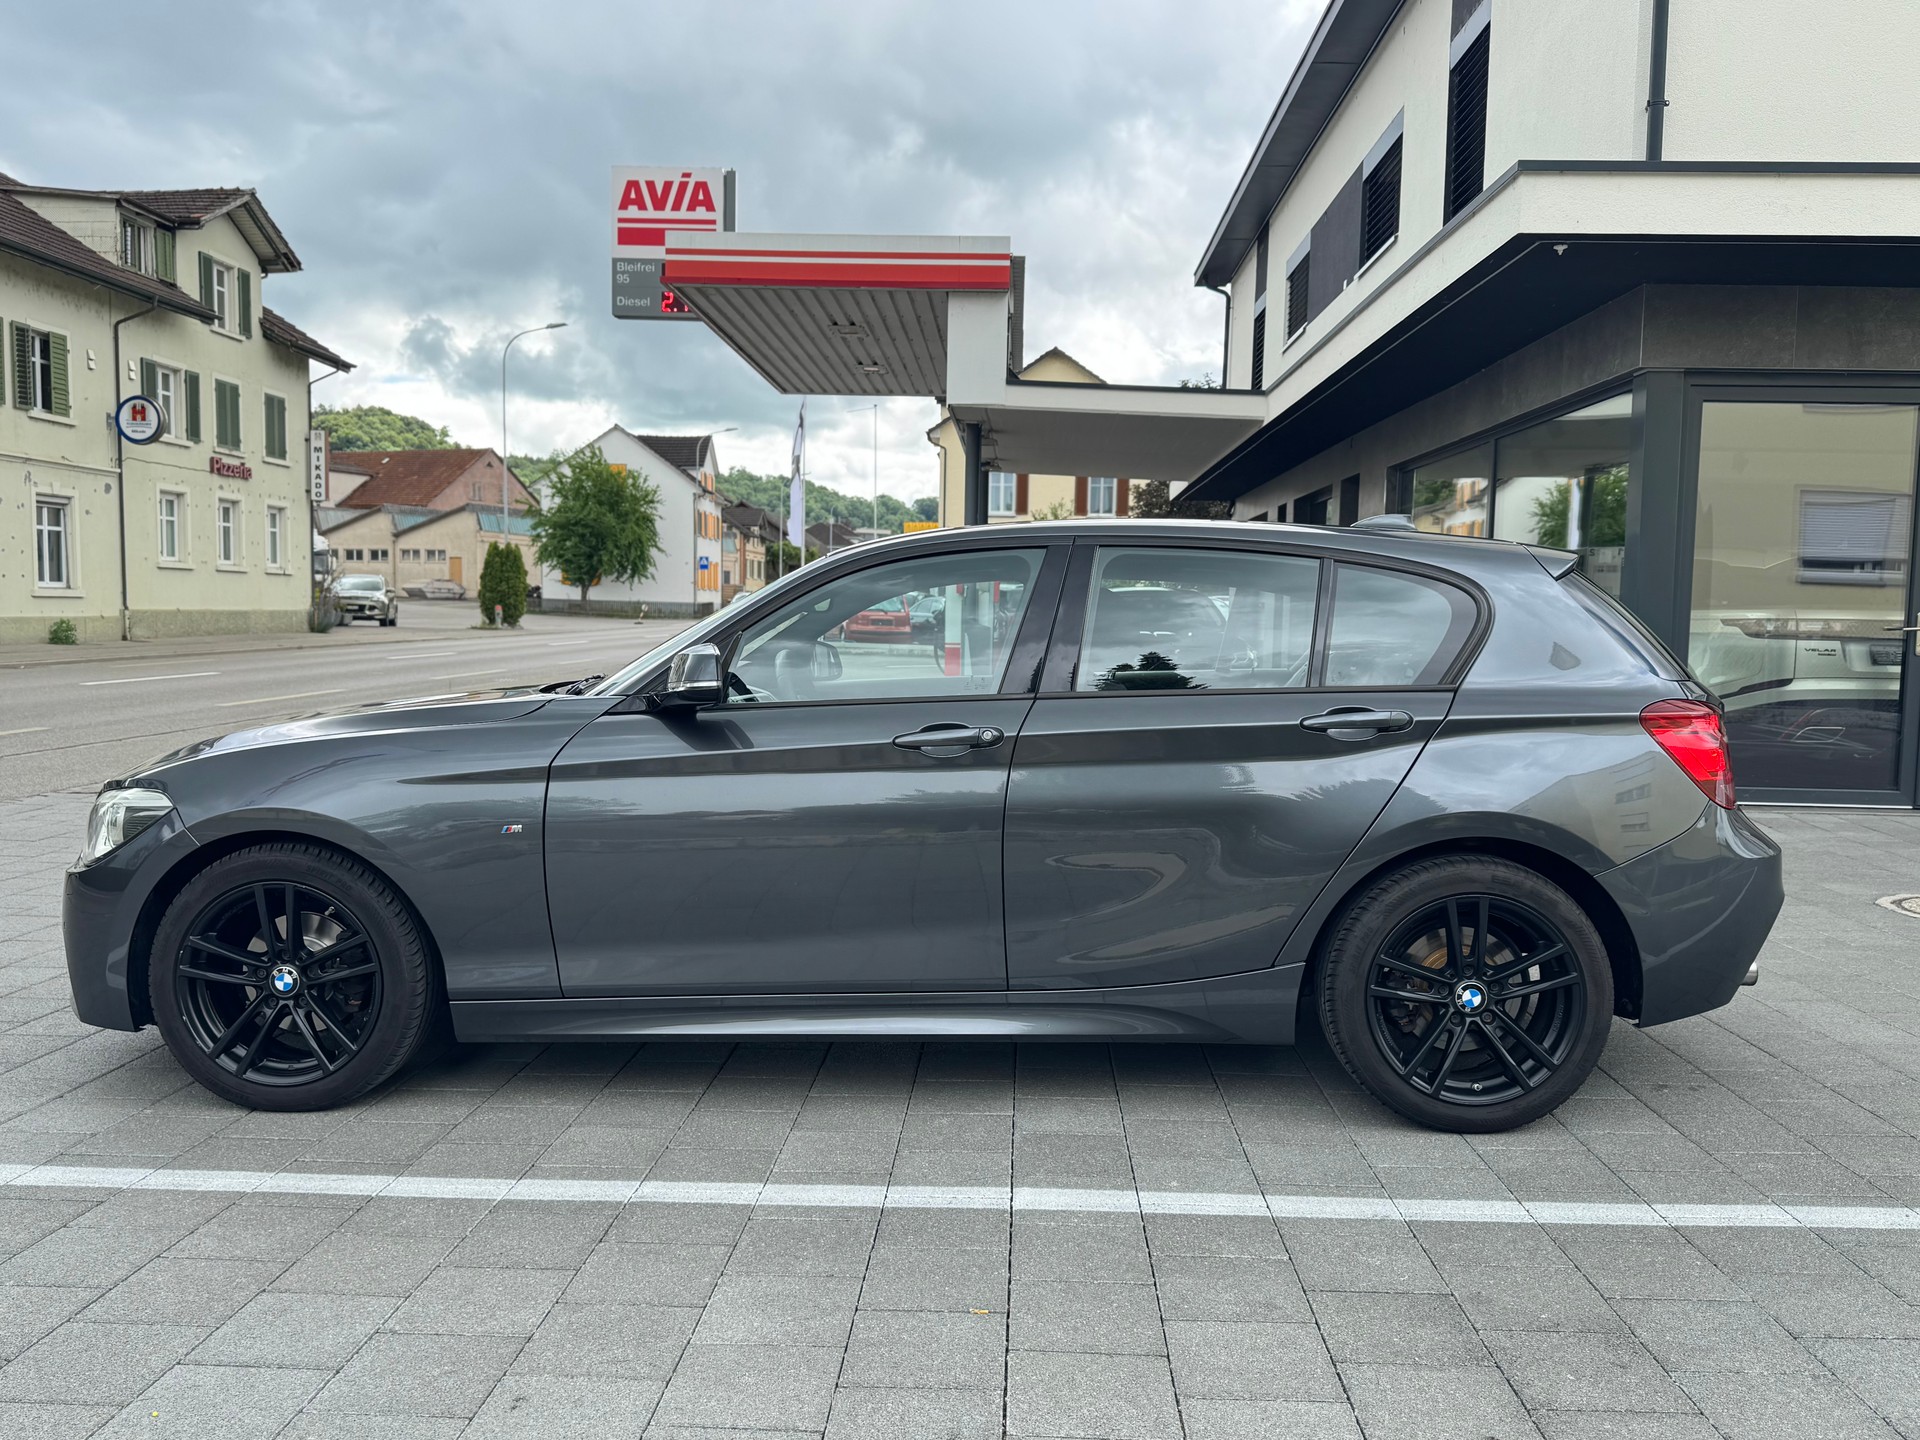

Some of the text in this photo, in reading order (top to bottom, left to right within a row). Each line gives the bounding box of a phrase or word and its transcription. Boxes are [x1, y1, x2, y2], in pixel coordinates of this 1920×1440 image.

[616, 262, 655, 273] Bleifrei
[616, 274, 630, 284] 95
[616, 296, 650, 307] Diesel
[213, 457, 253, 480] Pizzeria
[313, 446, 323, 498] MIKADO
